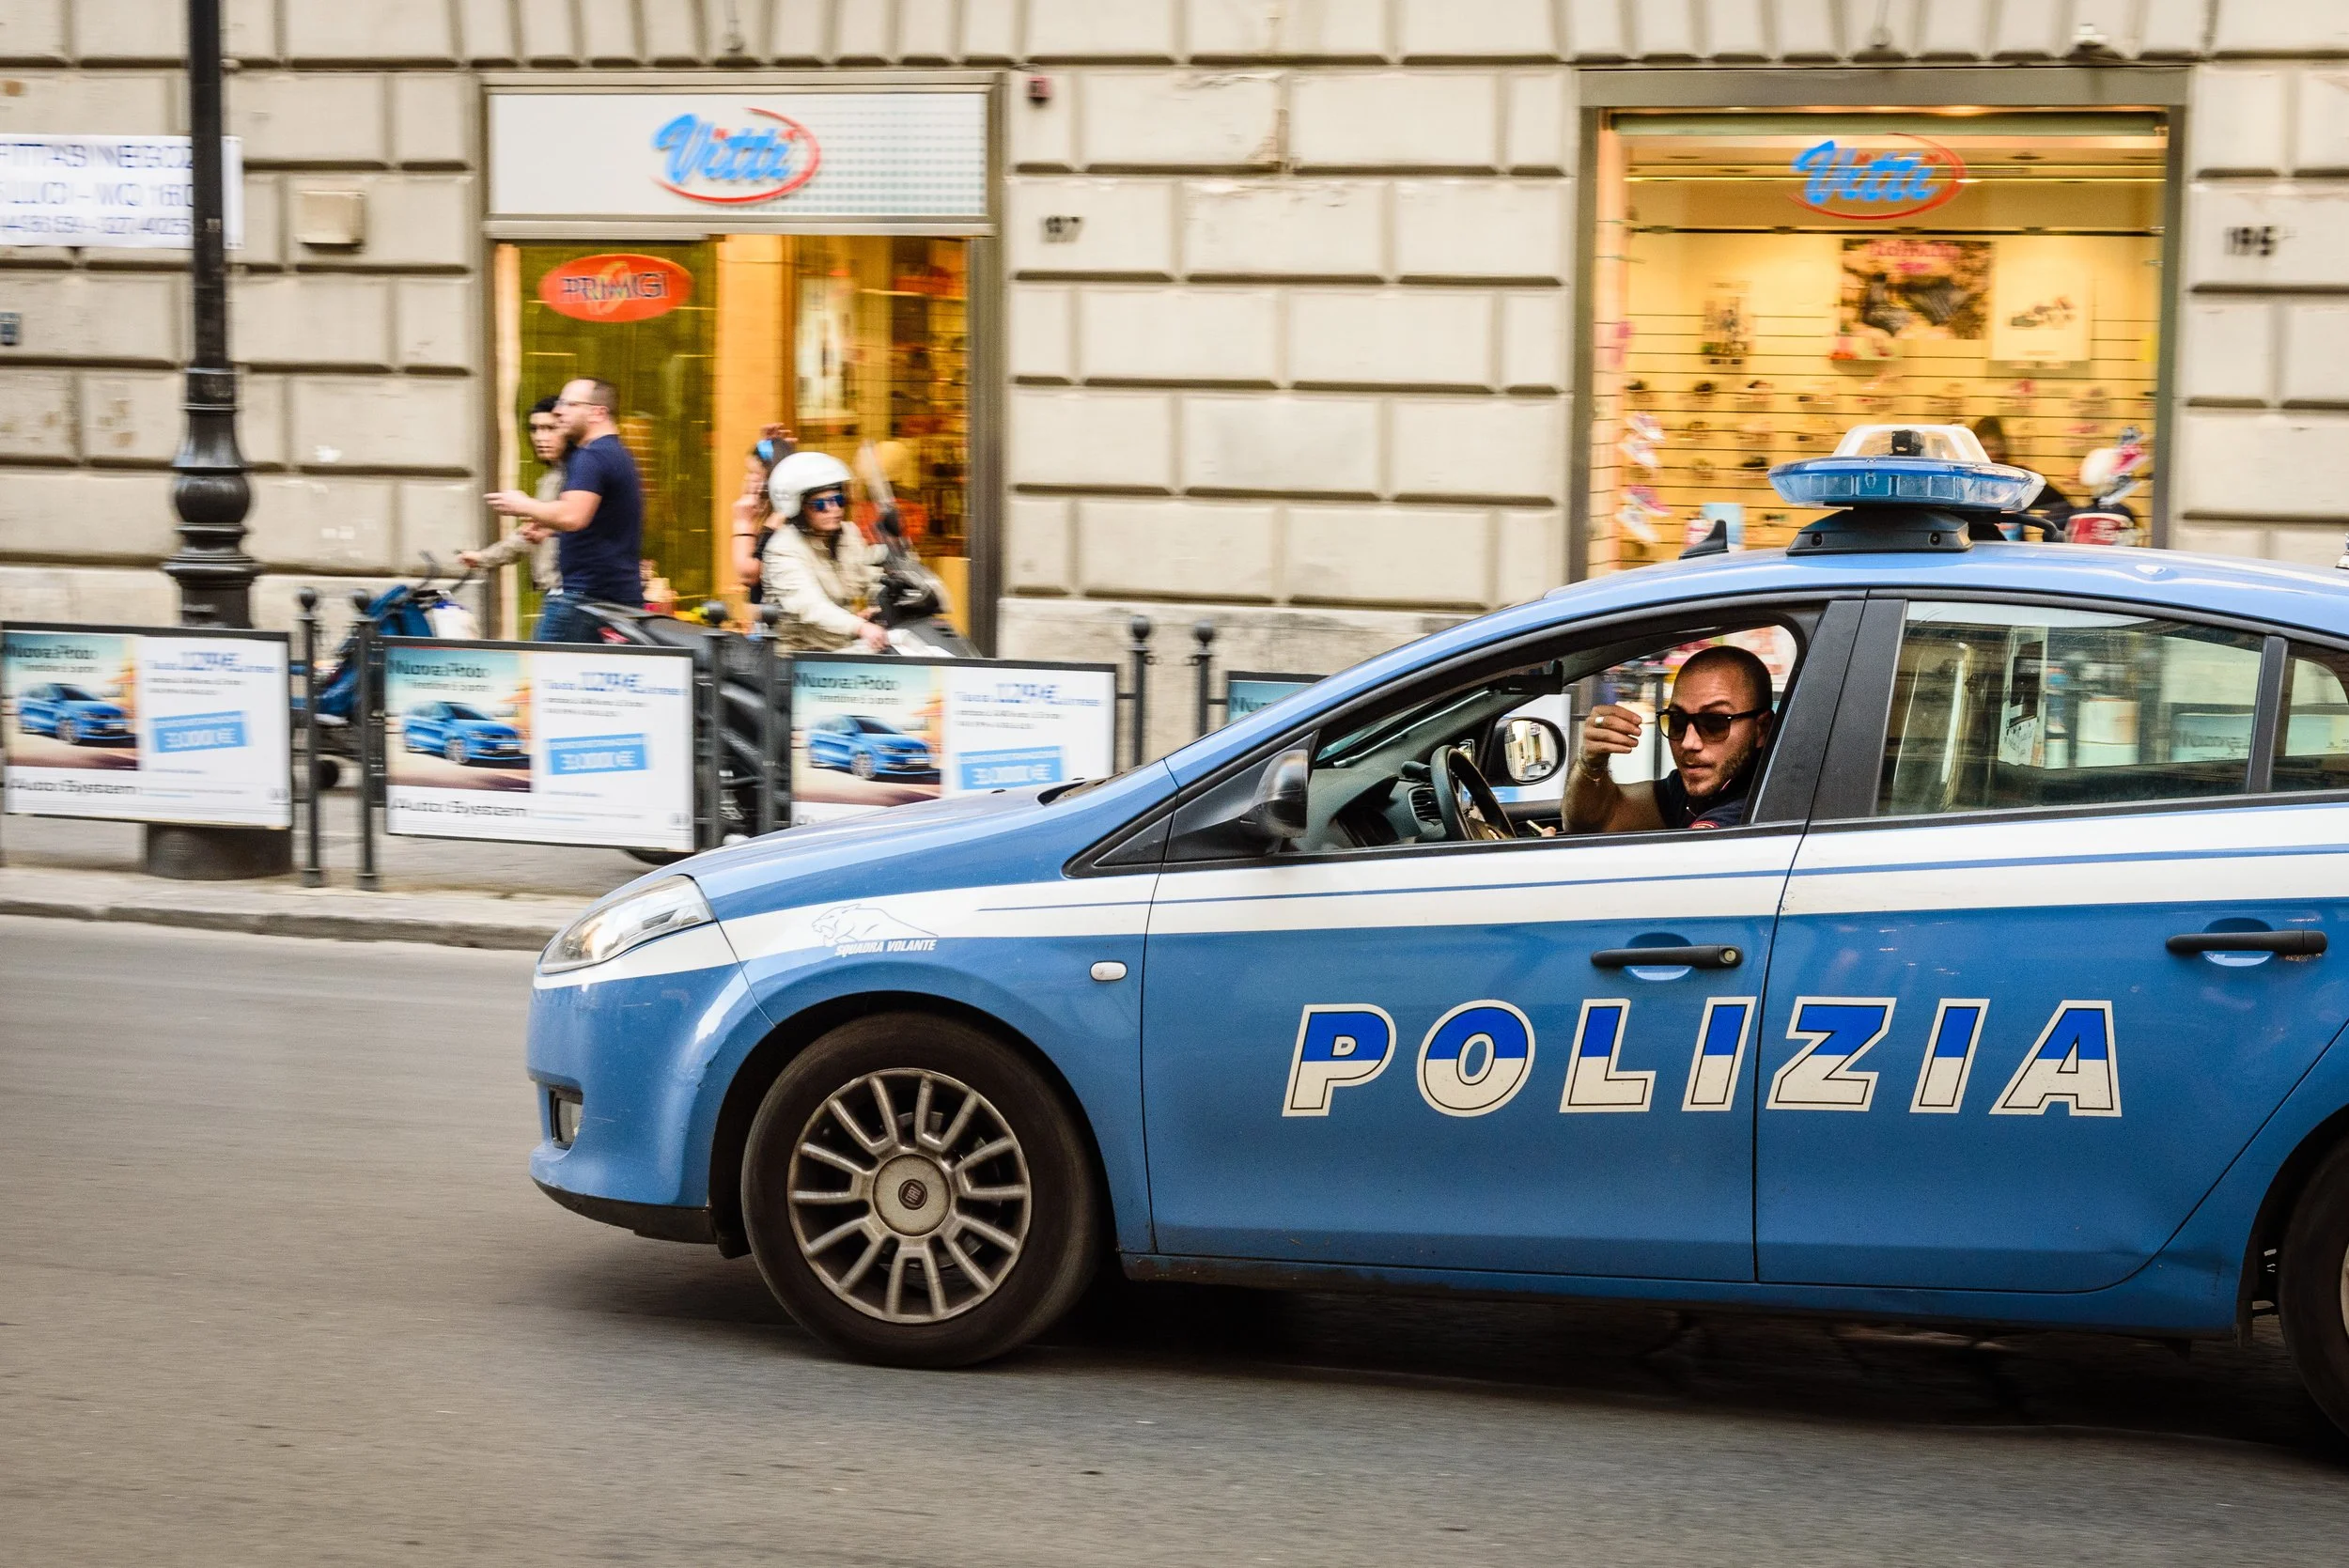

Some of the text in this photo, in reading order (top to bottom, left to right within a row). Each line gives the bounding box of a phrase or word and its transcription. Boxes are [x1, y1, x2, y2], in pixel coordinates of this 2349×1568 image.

[651, 112, 797, 184] Vitti
[1791, 140, 1941, 204] Vitti
[834, 939, 938, 957] SQUADRA VOLANTE
[1283, 997, 2123, 1117] POLIZIA
[905, 1185, 922, 1203] FIAT
